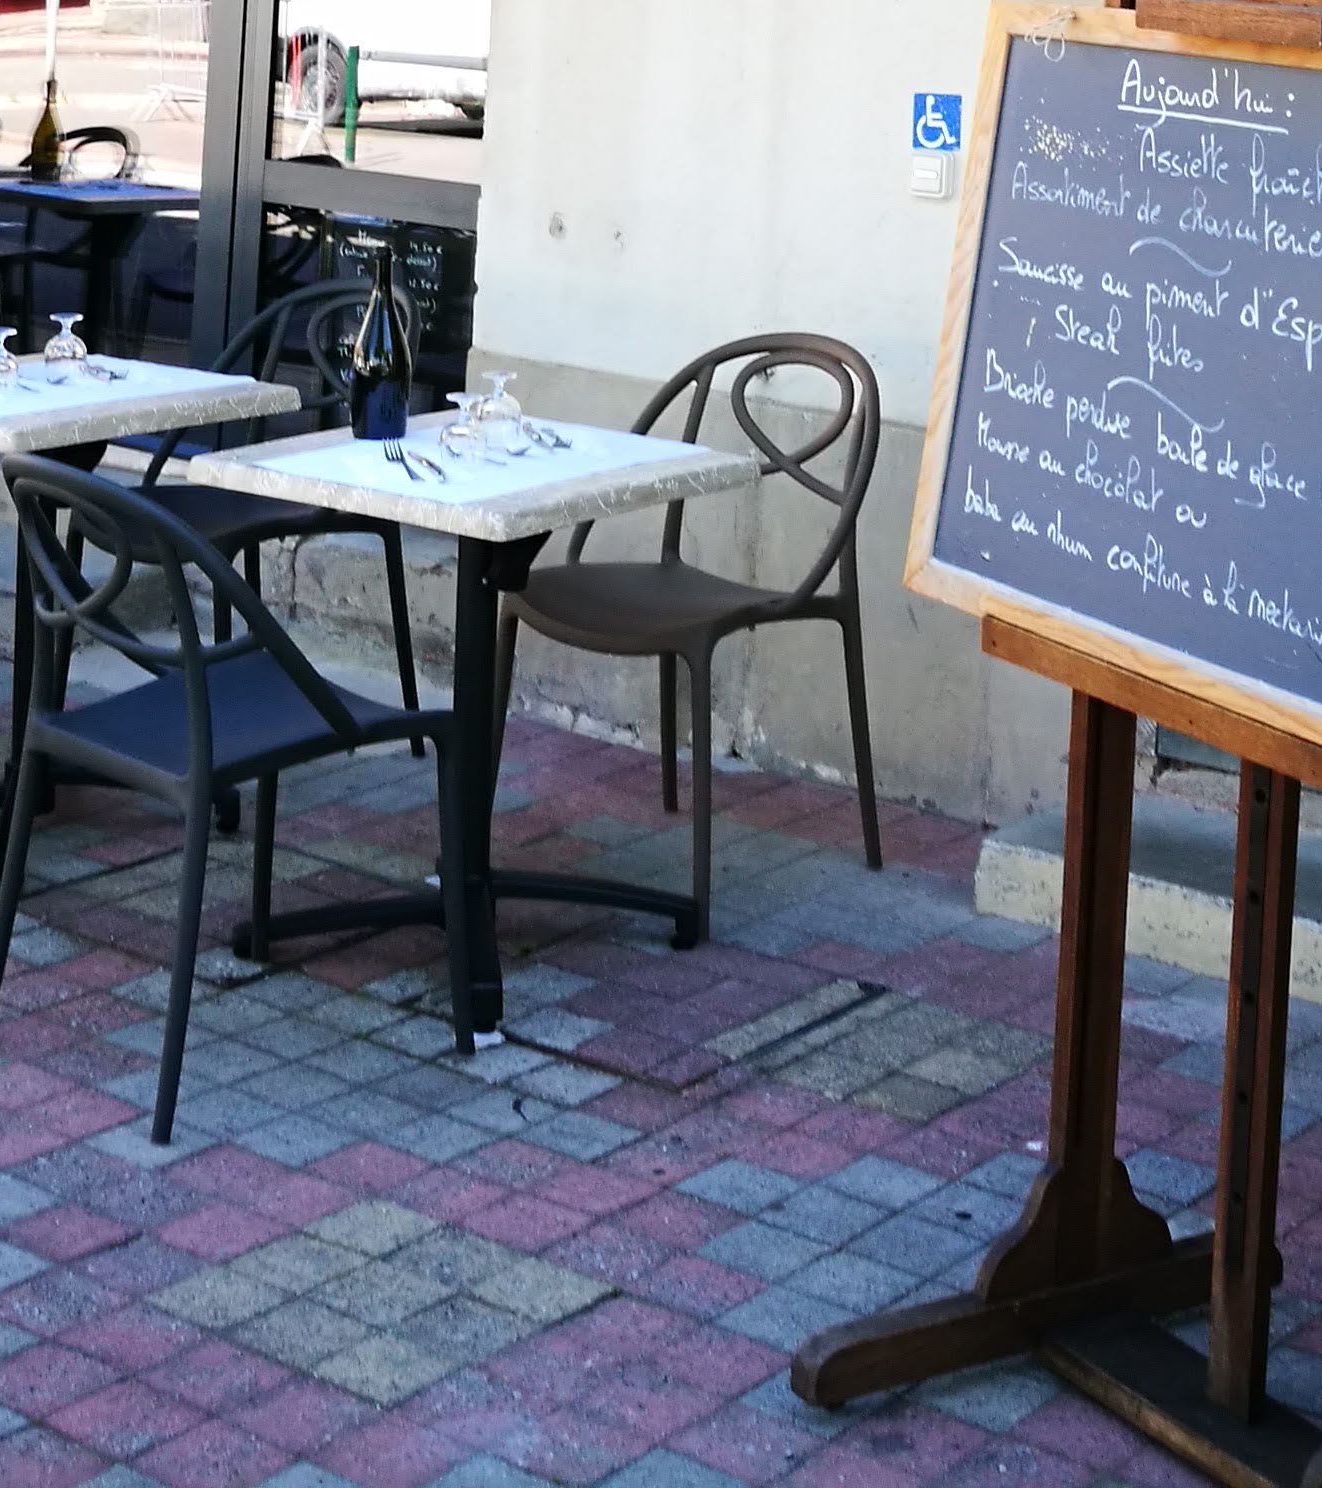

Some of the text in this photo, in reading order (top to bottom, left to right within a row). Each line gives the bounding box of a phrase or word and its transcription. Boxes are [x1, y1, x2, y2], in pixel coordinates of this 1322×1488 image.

[1012, 159, 1130, 218] Assortiment
[1136, 190, 1162, 225] de
[1139, 127, 1229, 185] Assiette
[998, 237, 1085, 292] Saucisse
[1101, 273, 1133, 299] au
[1146, 278, 1229, 331] piment
[1055, 303, 1205, 382] Steak frites
[977, 411, 1207, 528] Mousse au chocolat ou
[983, 347, 1055, 409] Brioche
[1067, 390, 1132, 438] perdue
[1157, 411, 1208, 472] boule
[1216, 440, 1239, 477] de
[1235, 440, 1307, 508] glace
[1012, 510, 1039, 535] au
[1107, 532, 1190, 598] confiture
[1202, 573, 1218, 606] à
